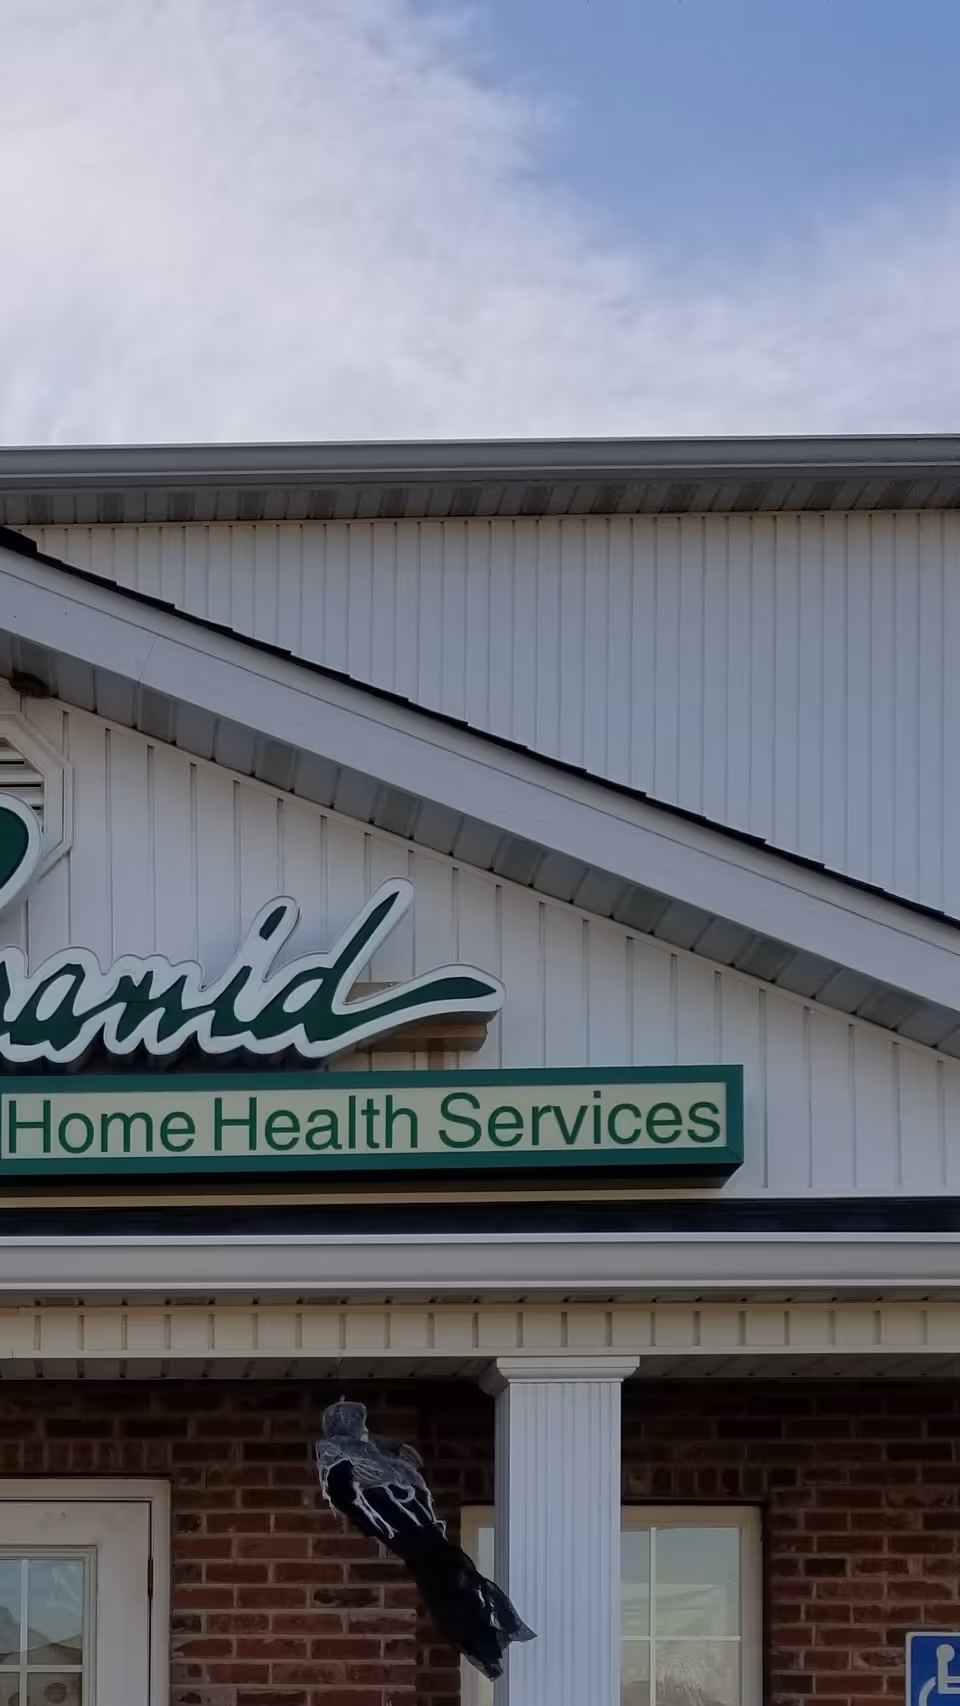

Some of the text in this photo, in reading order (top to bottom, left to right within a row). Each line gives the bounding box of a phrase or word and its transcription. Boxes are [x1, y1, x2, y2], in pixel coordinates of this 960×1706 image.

[9, 1090, 722, 1154] Home Health Services
